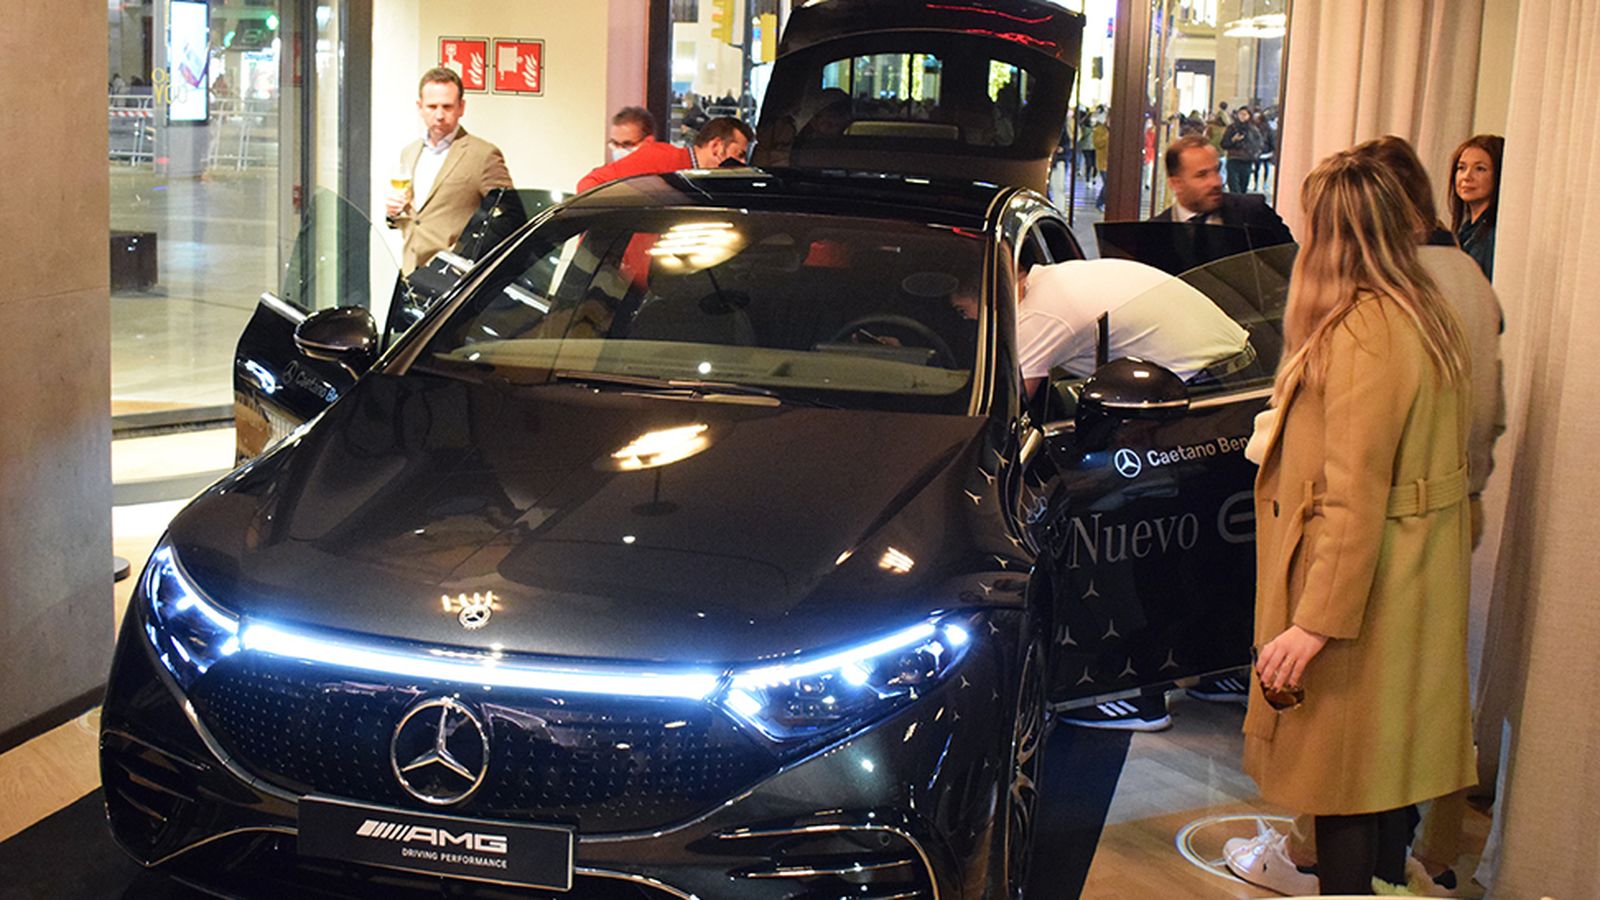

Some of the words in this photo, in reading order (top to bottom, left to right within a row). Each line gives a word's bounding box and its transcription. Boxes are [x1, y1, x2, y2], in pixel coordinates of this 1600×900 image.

[1146, 443, 1216, 467] Caetano
[1066, 513, 1199, 570] Nuevo
[402, 825, 508, 853] AMG
[401, 847, 438, 861] DRIVING
[440, 852, 508, 869] PERFORMANCE
